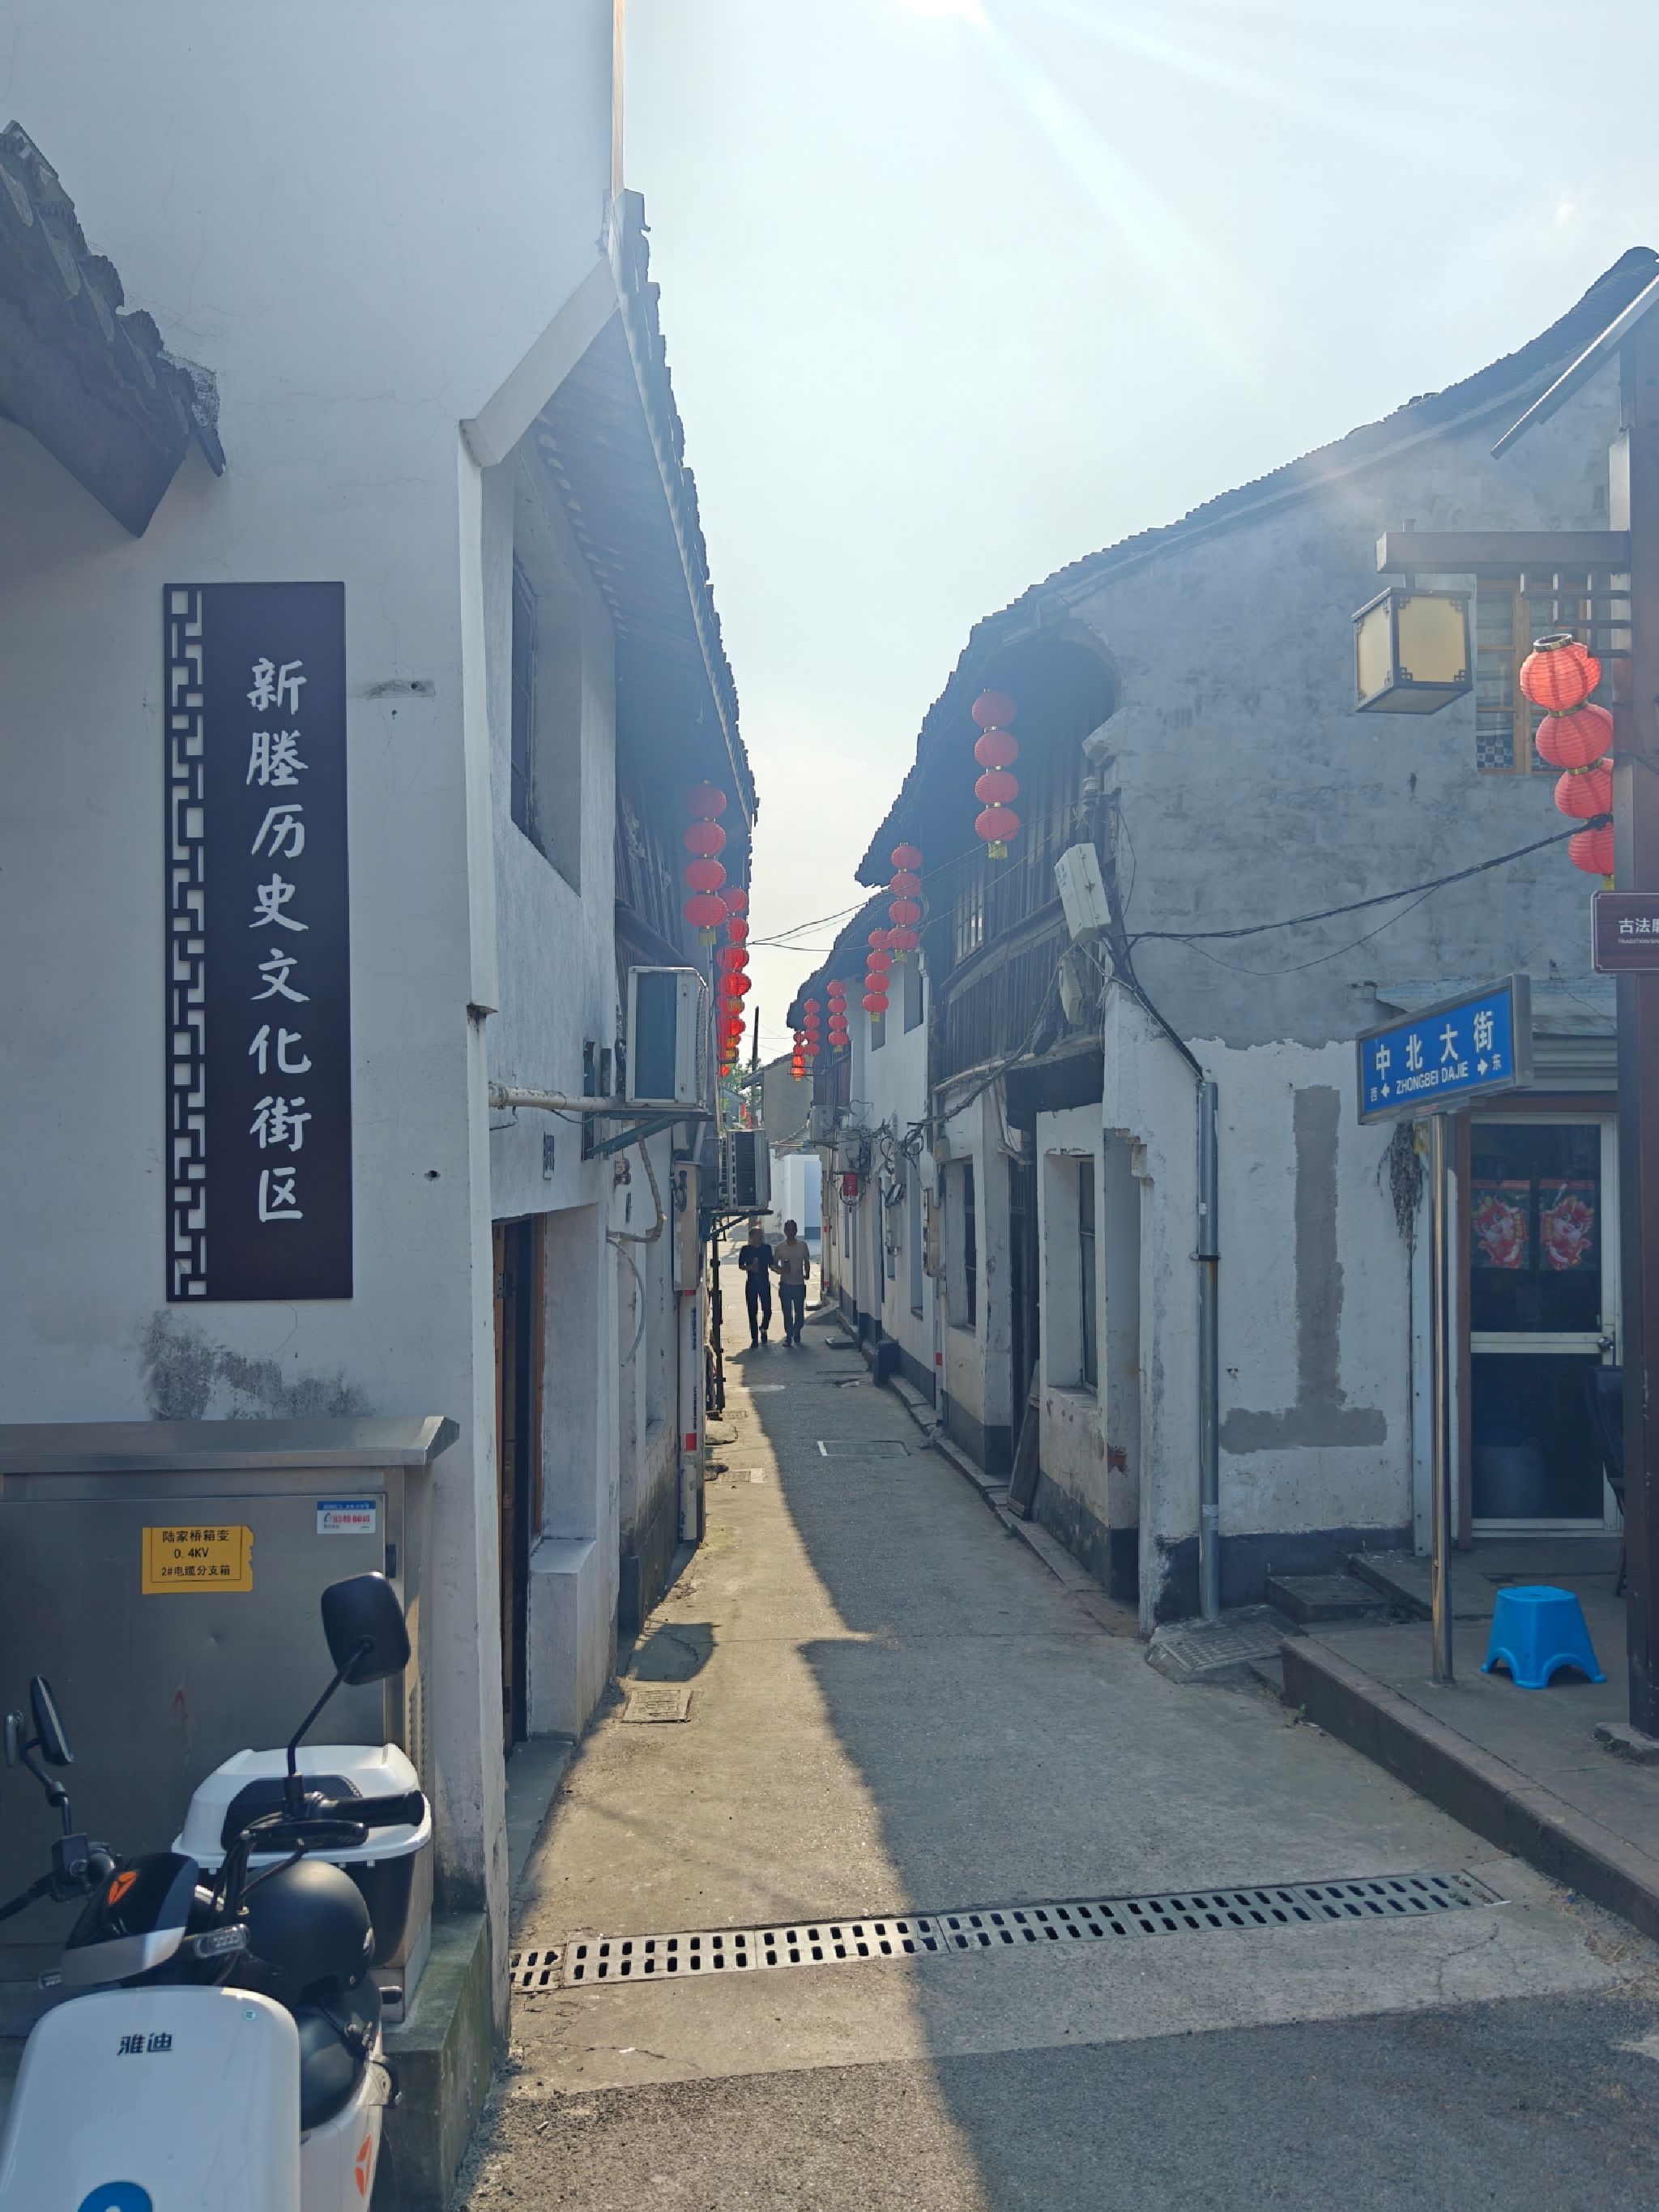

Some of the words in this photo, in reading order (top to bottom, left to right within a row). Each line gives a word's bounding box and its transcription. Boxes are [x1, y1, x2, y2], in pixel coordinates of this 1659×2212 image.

[1375, 1010, 1494, 1080] 中北大街
[1492, 1053, 1502, 1071] 东
[1396, 1070, 1439, 1095] ZHONGBEI
[1441, 1061, 1469, 1083] DAJIE
[1370, 1087, 1378, 1103] 西
[117, 2031, 173, 2056] 雅迪
